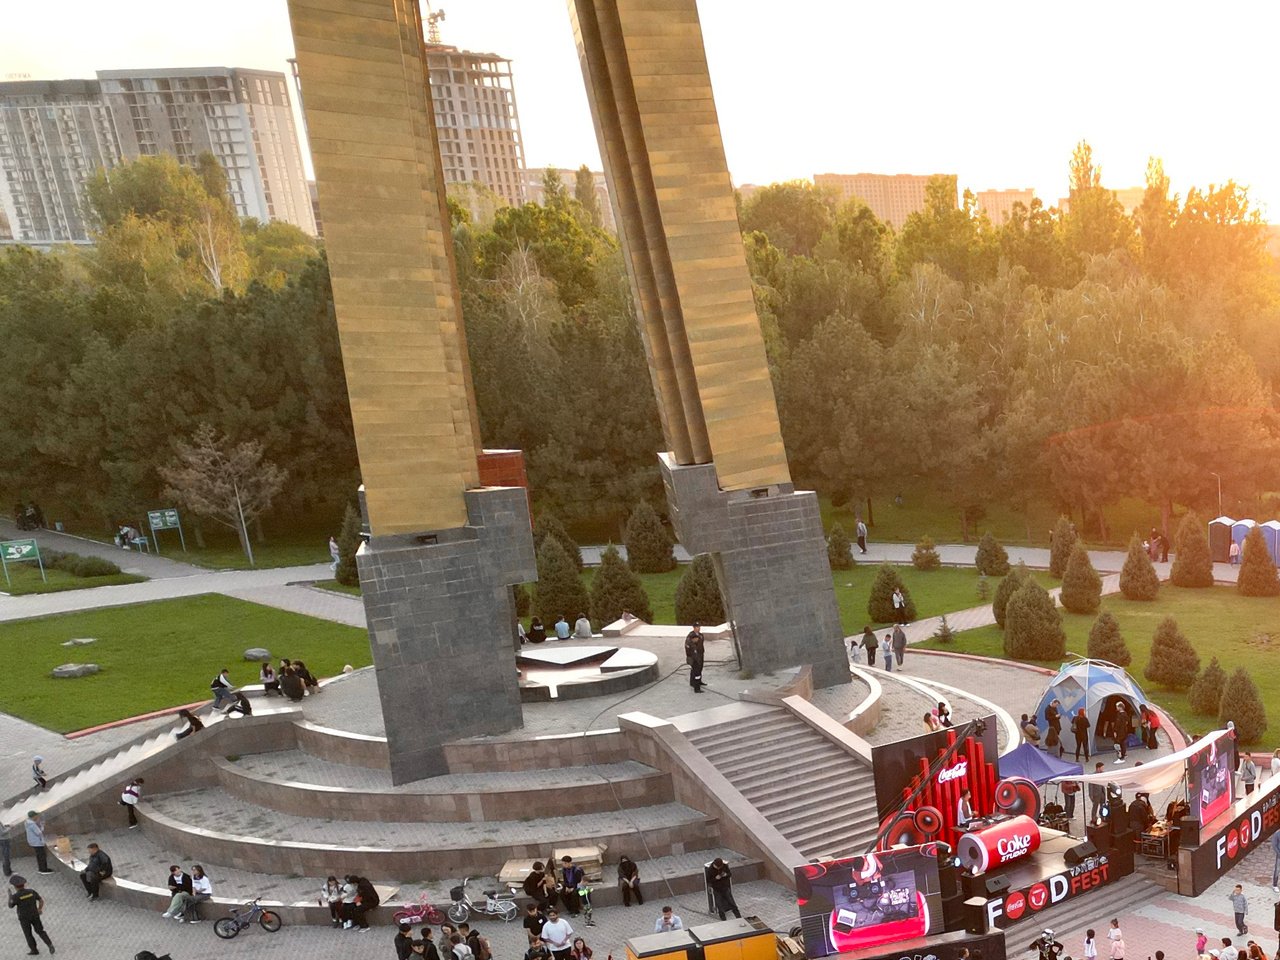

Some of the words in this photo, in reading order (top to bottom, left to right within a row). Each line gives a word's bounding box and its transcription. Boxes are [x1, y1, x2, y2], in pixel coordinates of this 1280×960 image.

[997, 834, 1031, 856] Coke
[1000, 847, 1028, 863] STUDIO
[1070, 863, 1110, 895] FEST
